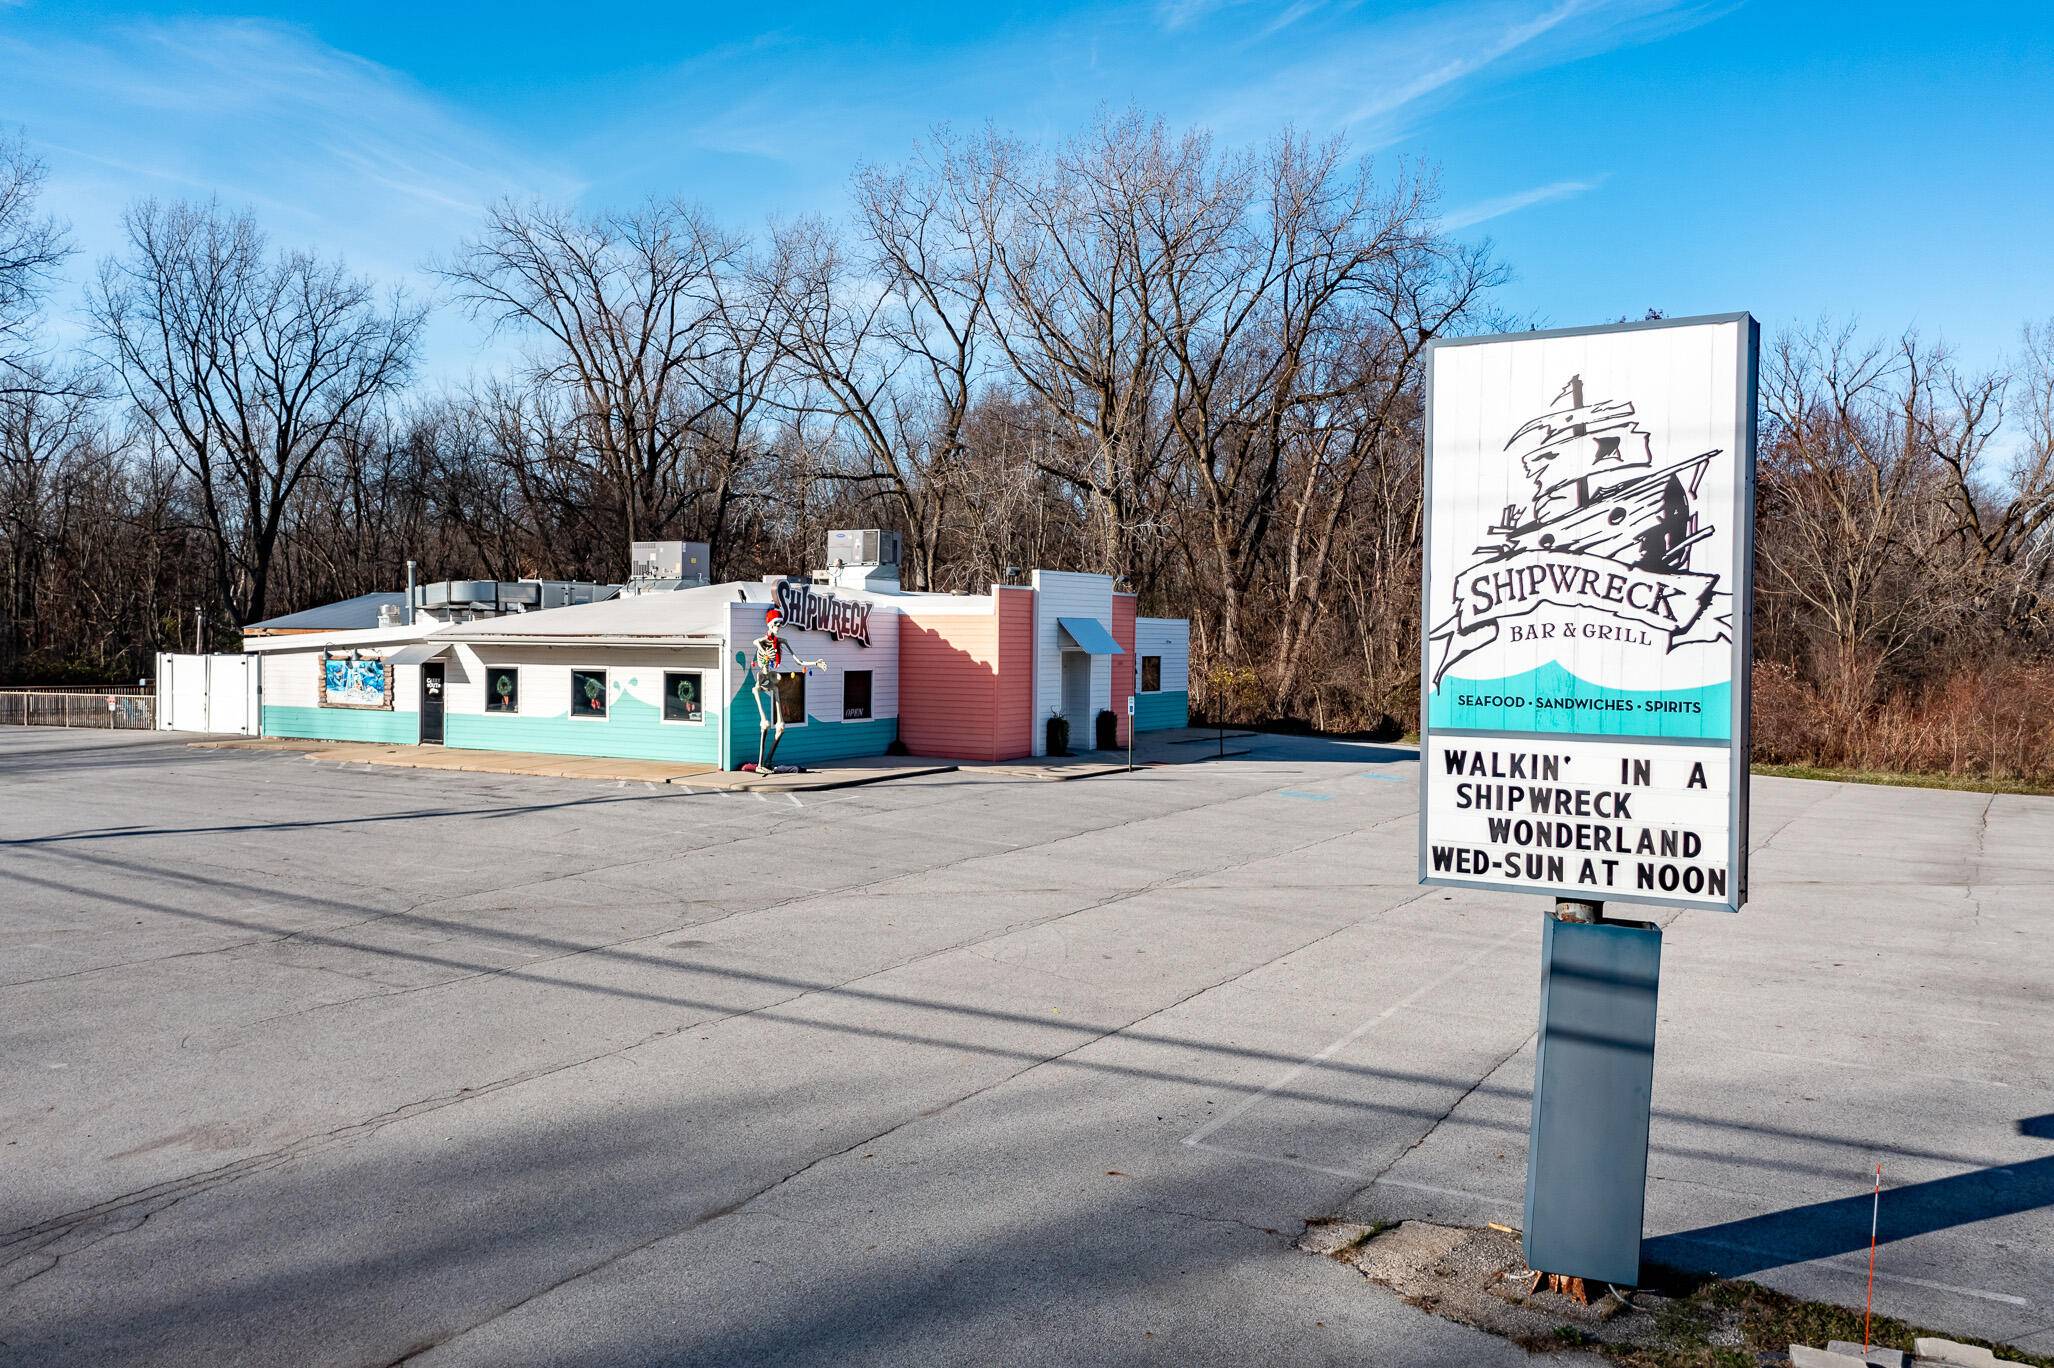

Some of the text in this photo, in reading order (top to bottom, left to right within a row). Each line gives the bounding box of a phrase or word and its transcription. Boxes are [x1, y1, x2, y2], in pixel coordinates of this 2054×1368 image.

[1471, 563, 1687, 623] SHIPWRECK
[777, 579, 875, 648] SHIPWRECK
[1510, 622, 1652, 646] BAR & GRILL
[845, 708, 864, 718] OPEN
[1458, 695, 1702, 714] SEAFOOD SANDWICHES SPIRITS
[1444, 749, 1708, 789] WALKIN' IN A
[1456, 783, 1632, 819] SHIPWRECK
[1488, 817, 1702, 858] WONDERLAND
[1432, 845, 1726, 896] WED-SUN AT NOON
